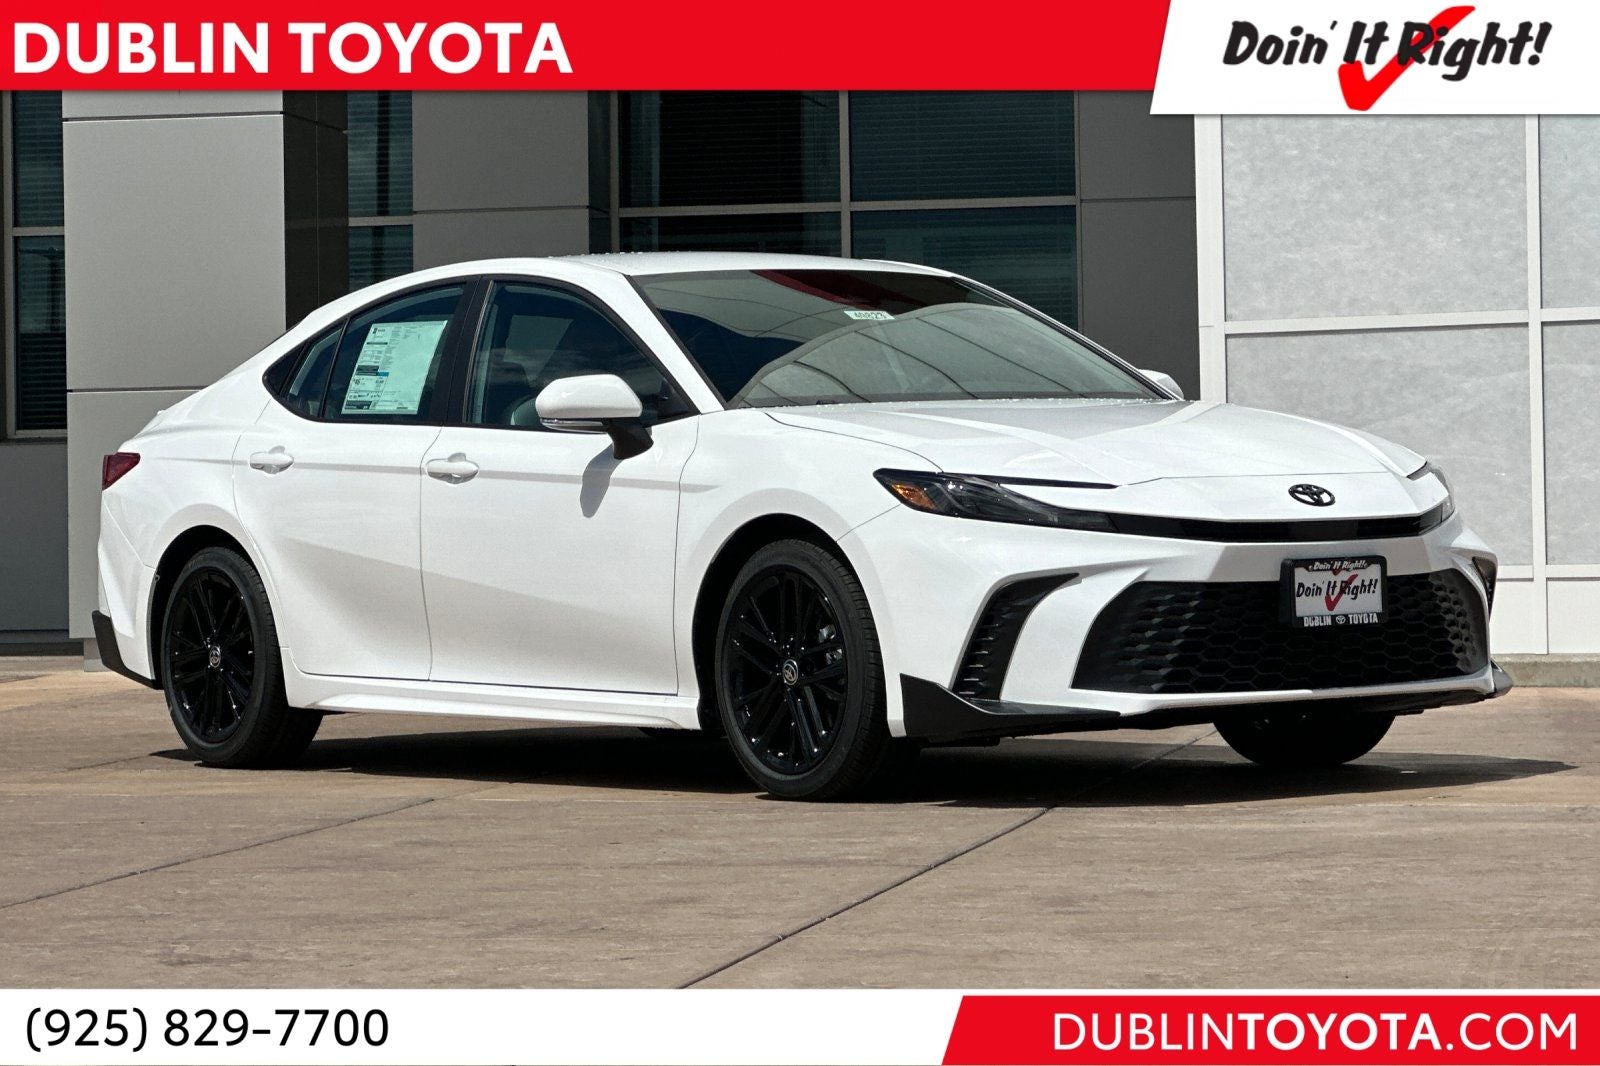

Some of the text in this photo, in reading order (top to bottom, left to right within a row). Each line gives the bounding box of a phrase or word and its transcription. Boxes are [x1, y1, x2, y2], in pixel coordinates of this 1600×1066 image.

[1296, 578, 1378, 600] Doin' It Right!
[1303, 612, 1379, 627] DUBLIN TOYOTA
